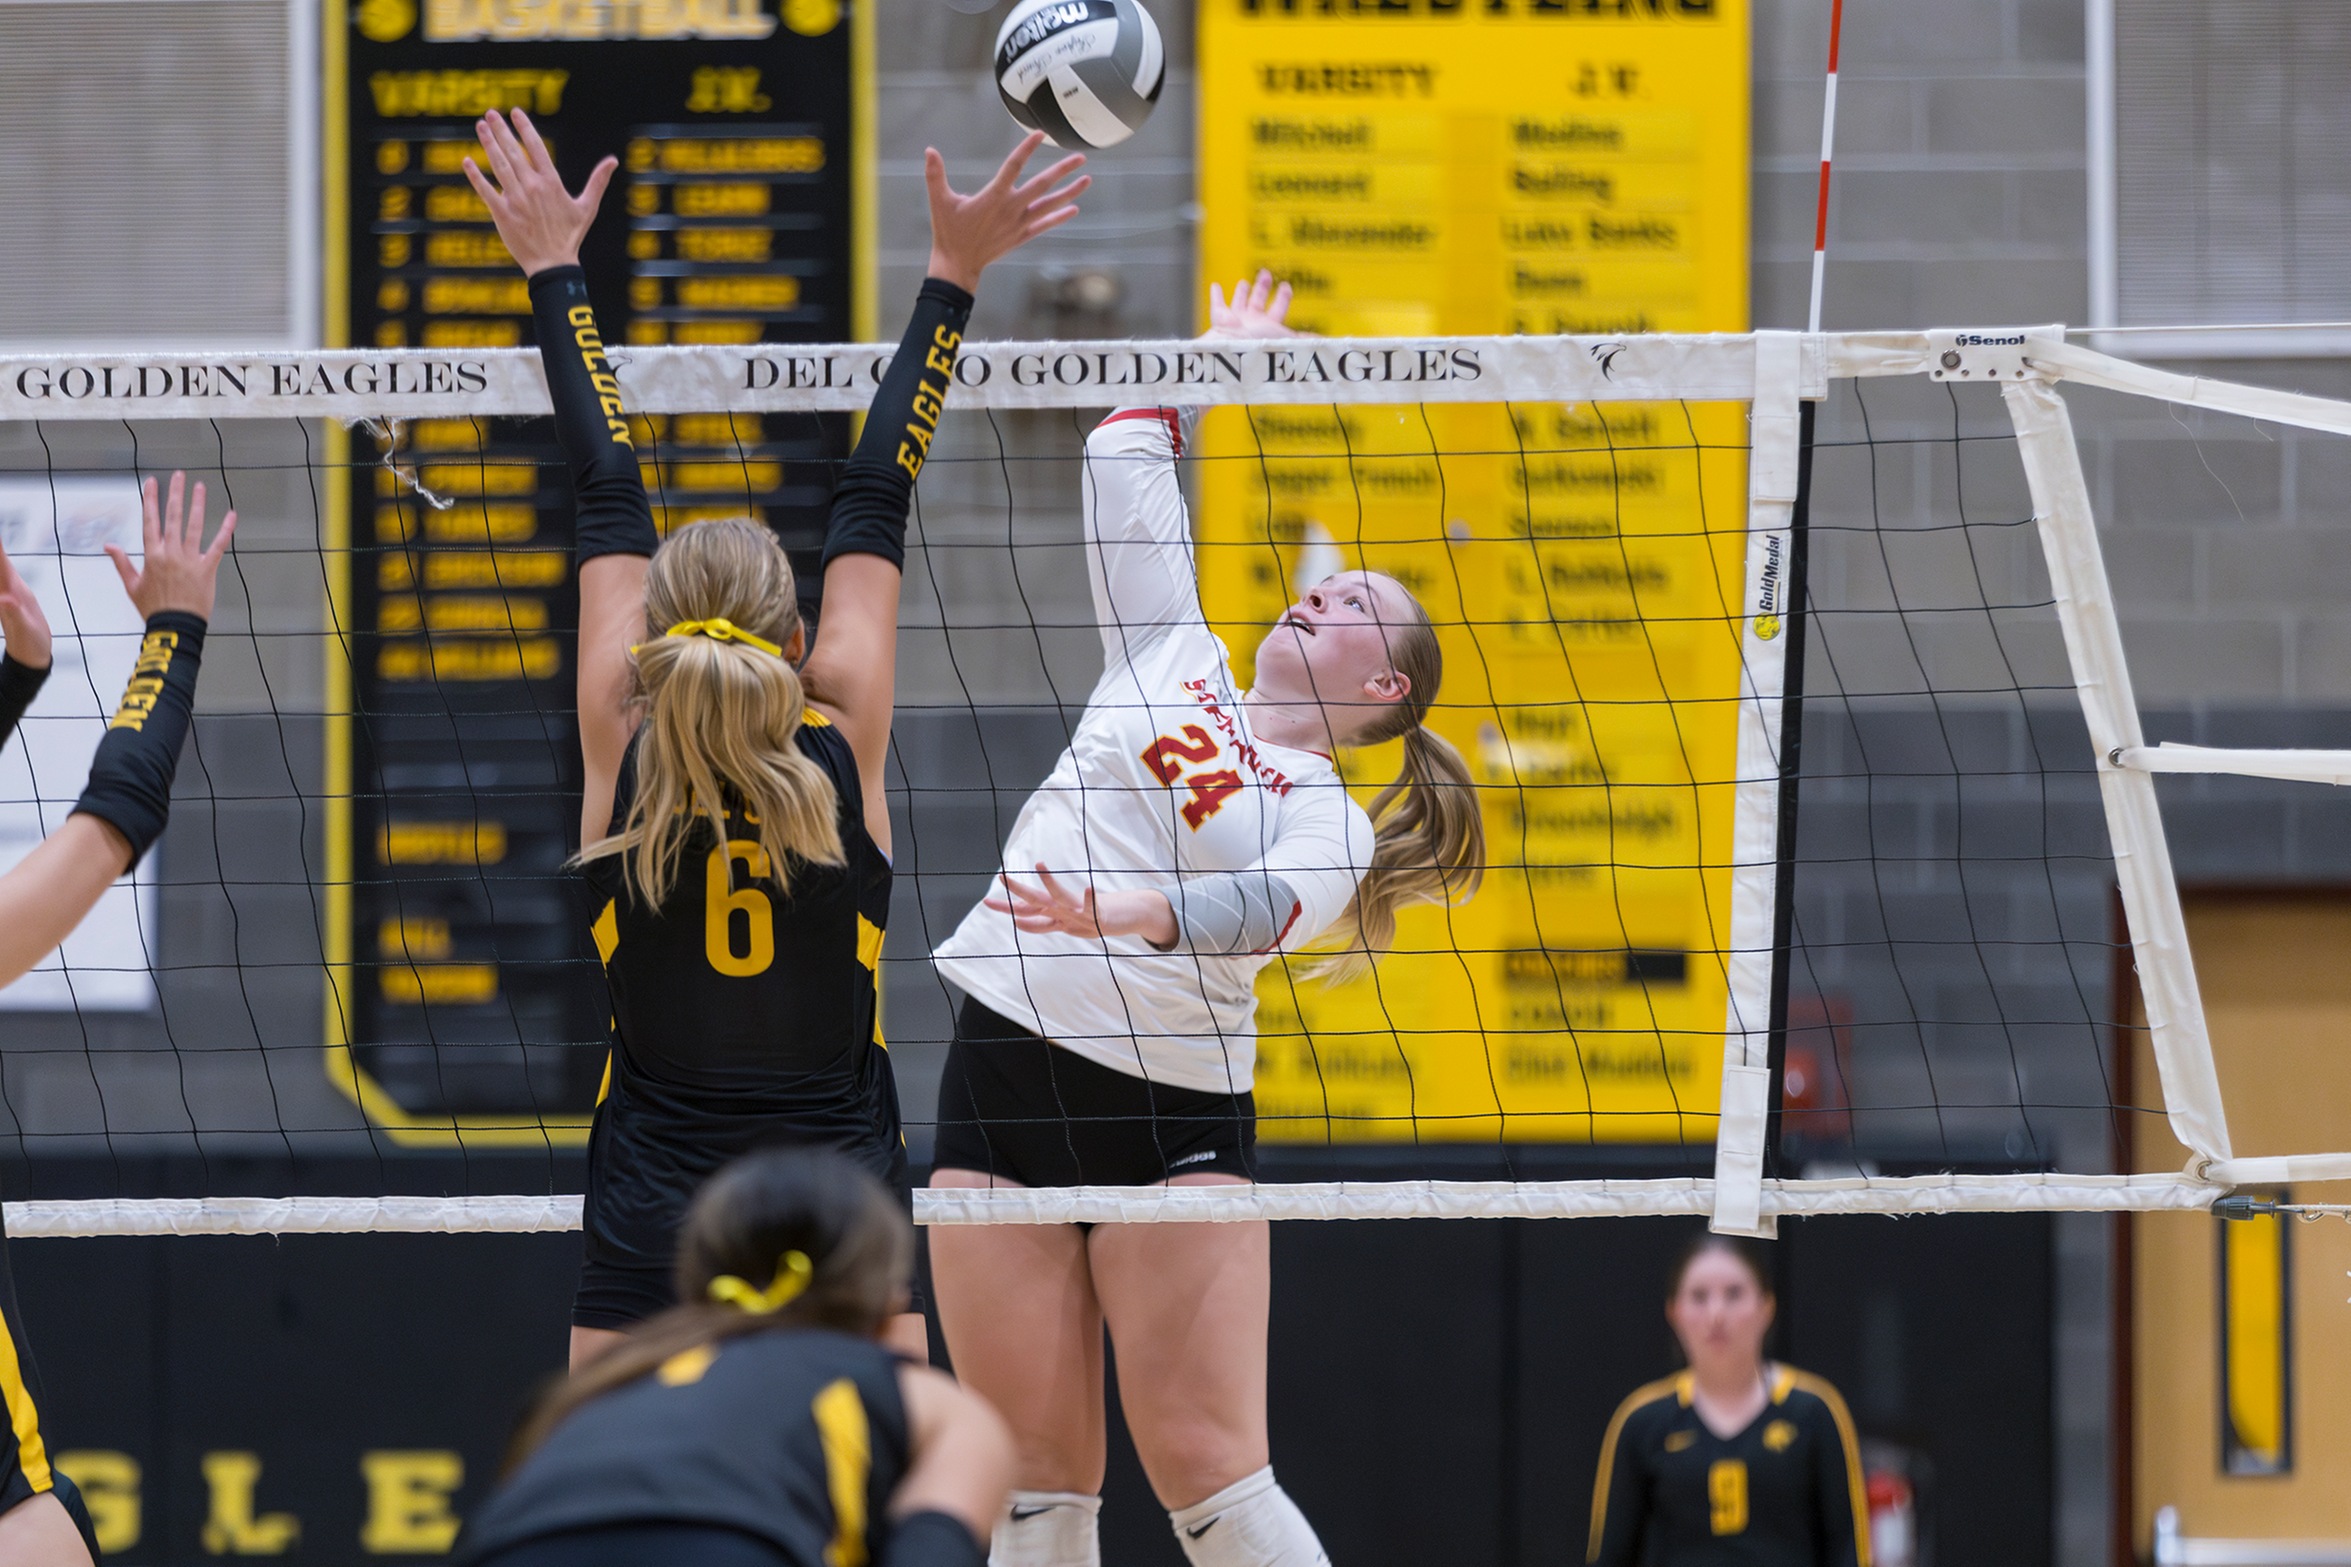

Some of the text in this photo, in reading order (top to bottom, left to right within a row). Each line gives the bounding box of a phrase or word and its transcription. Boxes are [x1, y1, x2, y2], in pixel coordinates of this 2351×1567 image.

[1256, 61, 1437, 97] VARSITY
[16, 361, 488, 399] GOLDEN EAGLES
[742, 355, 853, 390] DEL
[1011, 351, 1246, 386] GOLDEN
[1266, 348, 1482, 383] EAGLES
[897, 324, 961, 481] EAGLES
[1140, 723, 1244, 833] 24
[705, 839, 775, 978] 6
[1708, 1458, 1749, 1536] 9
